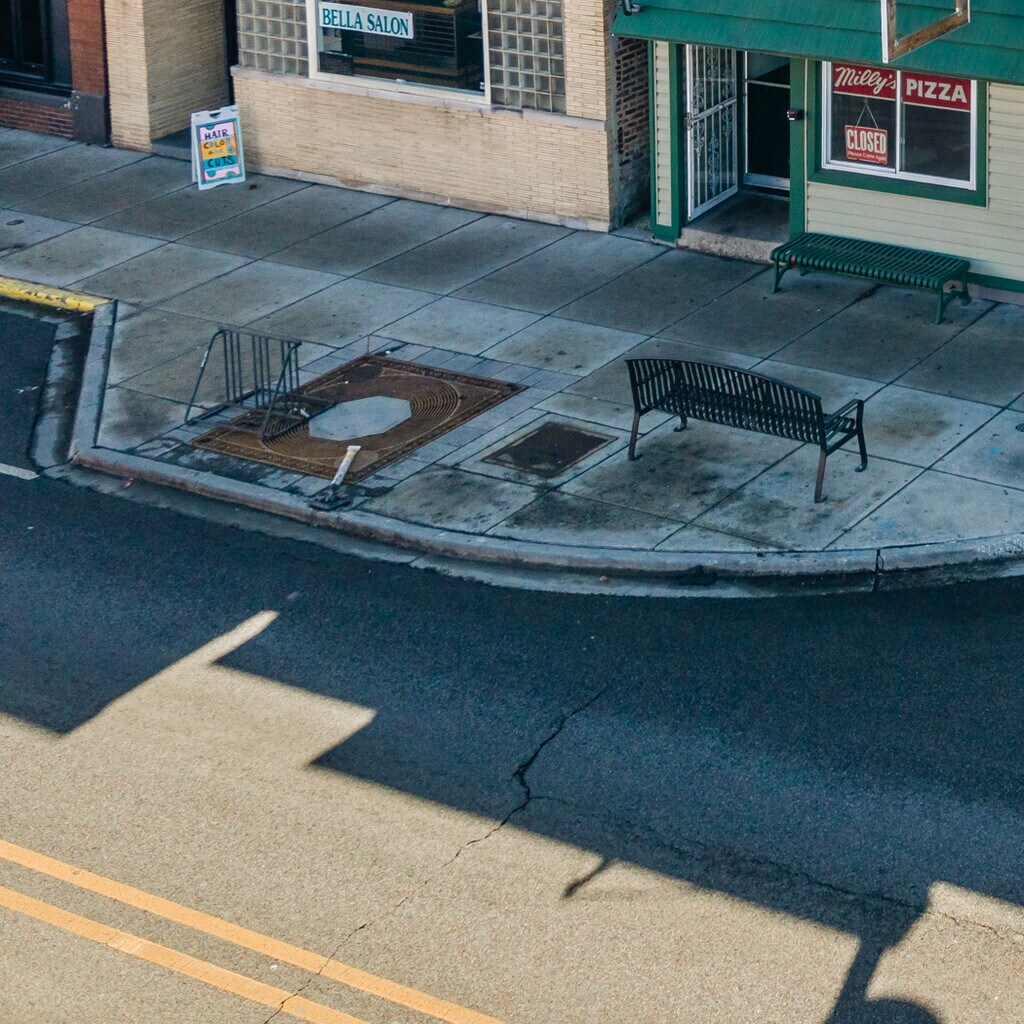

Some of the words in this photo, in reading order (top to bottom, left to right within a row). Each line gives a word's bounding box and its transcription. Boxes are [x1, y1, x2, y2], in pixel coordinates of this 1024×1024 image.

[322, 8, 363, 30] BELLA
[367, 13, 409, 36] SALON
[835, 66, 897, 95] Milly's
[906, 78, 967, 103] PIZZA
[204, 129, 229, 140] HAIR
[847, 129, 886, 154] CLOSED
[207, 155, 235, 168] CUTS
